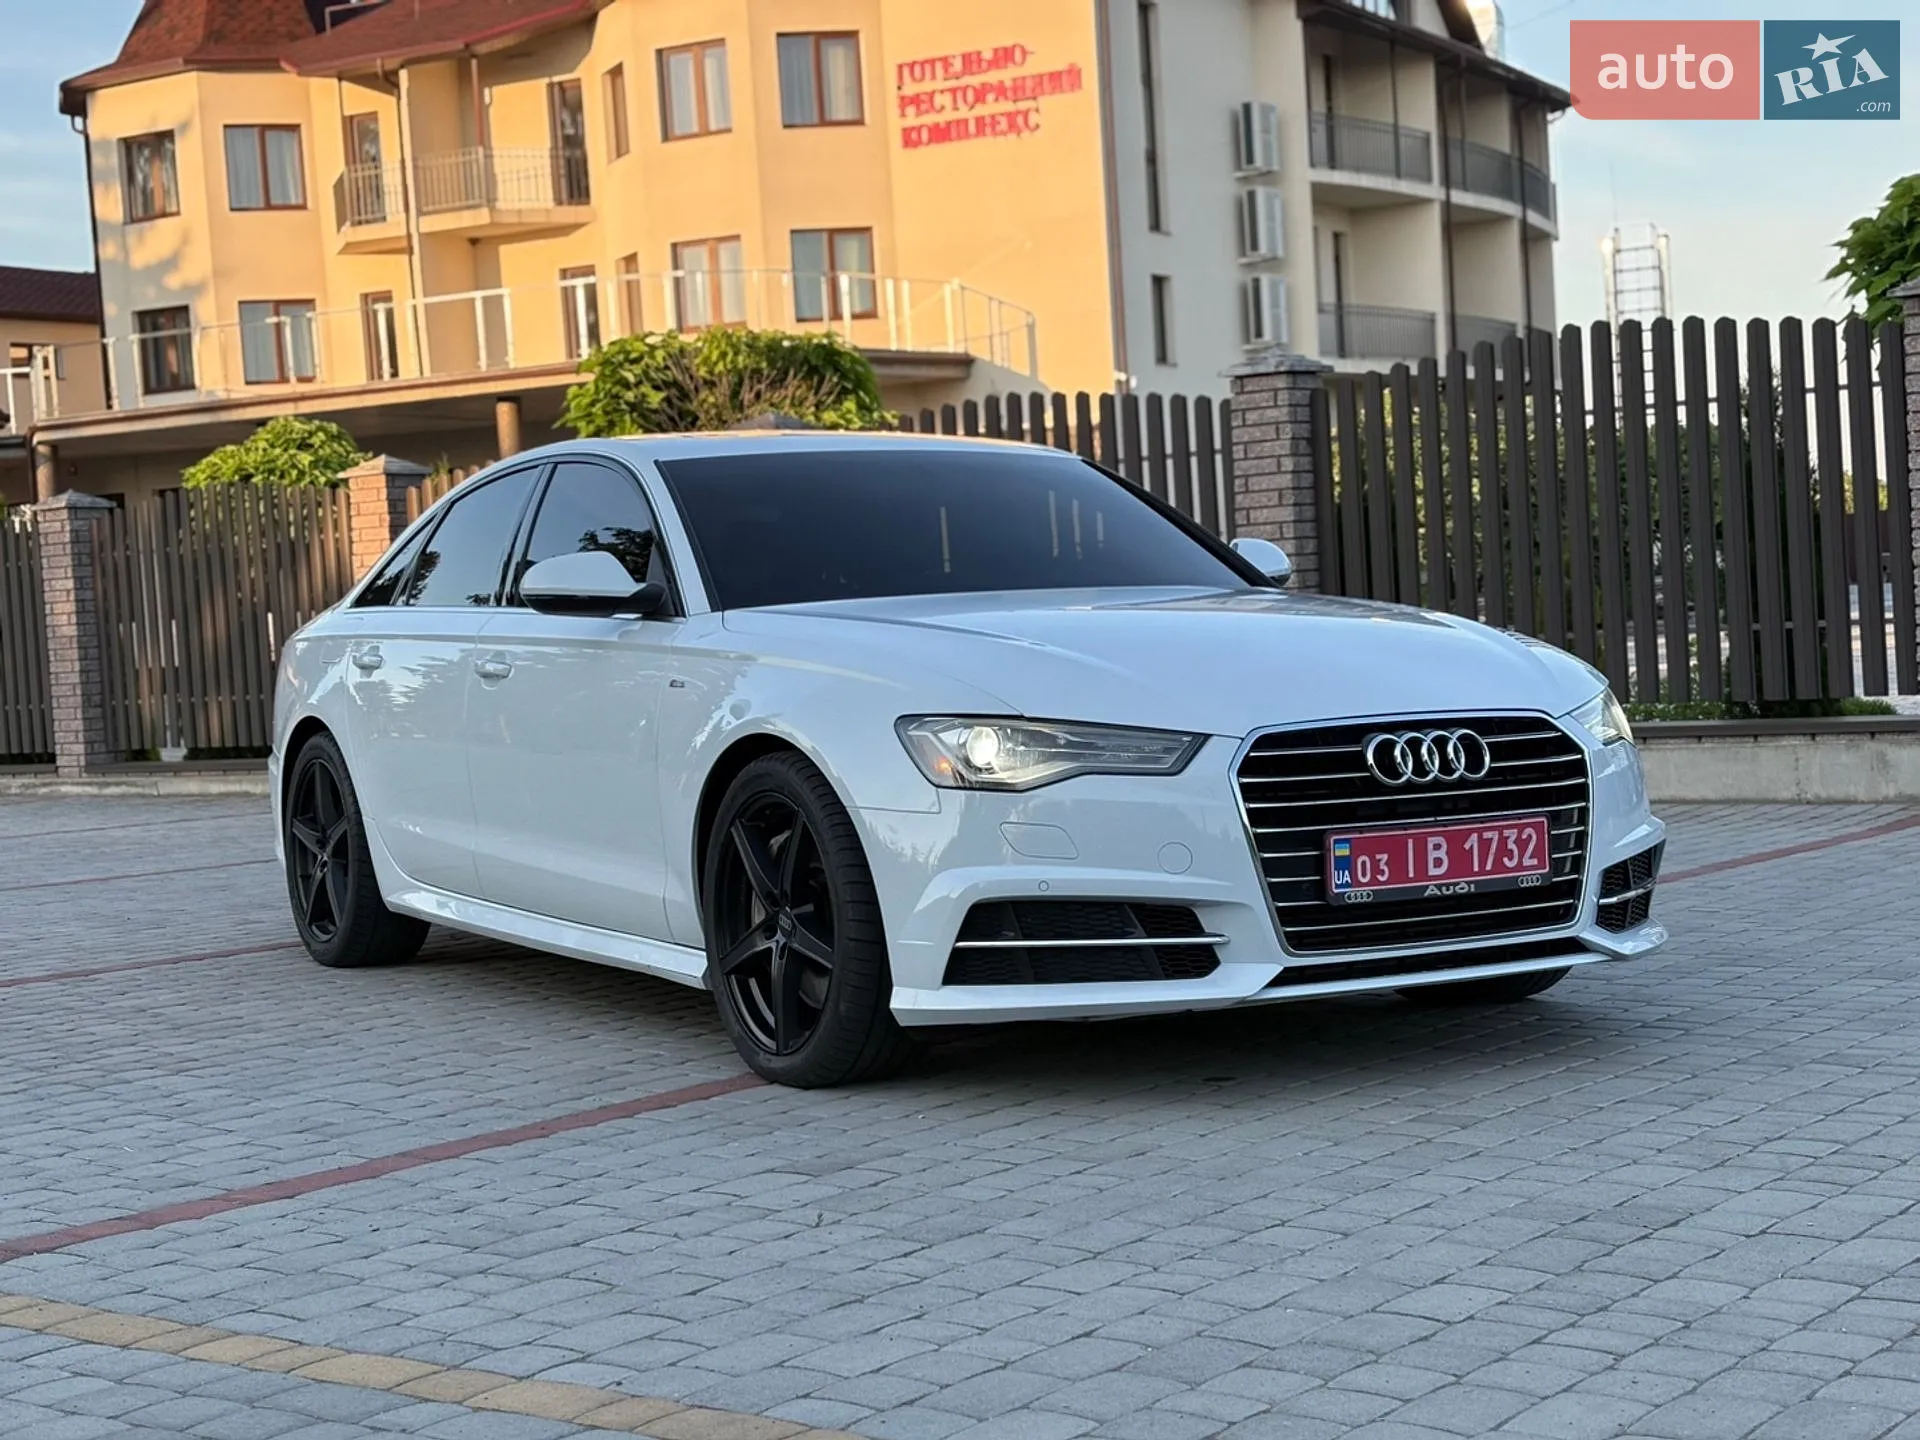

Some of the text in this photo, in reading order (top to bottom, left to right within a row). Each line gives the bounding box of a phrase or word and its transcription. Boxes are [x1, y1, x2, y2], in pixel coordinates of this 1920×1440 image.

[1357, 854, 1389, 883] 03
[1464, 828, 1538, 872] 1732
[1334, 870, 1351, 884] UA
[1424, 882, 1475, 897] Audi
